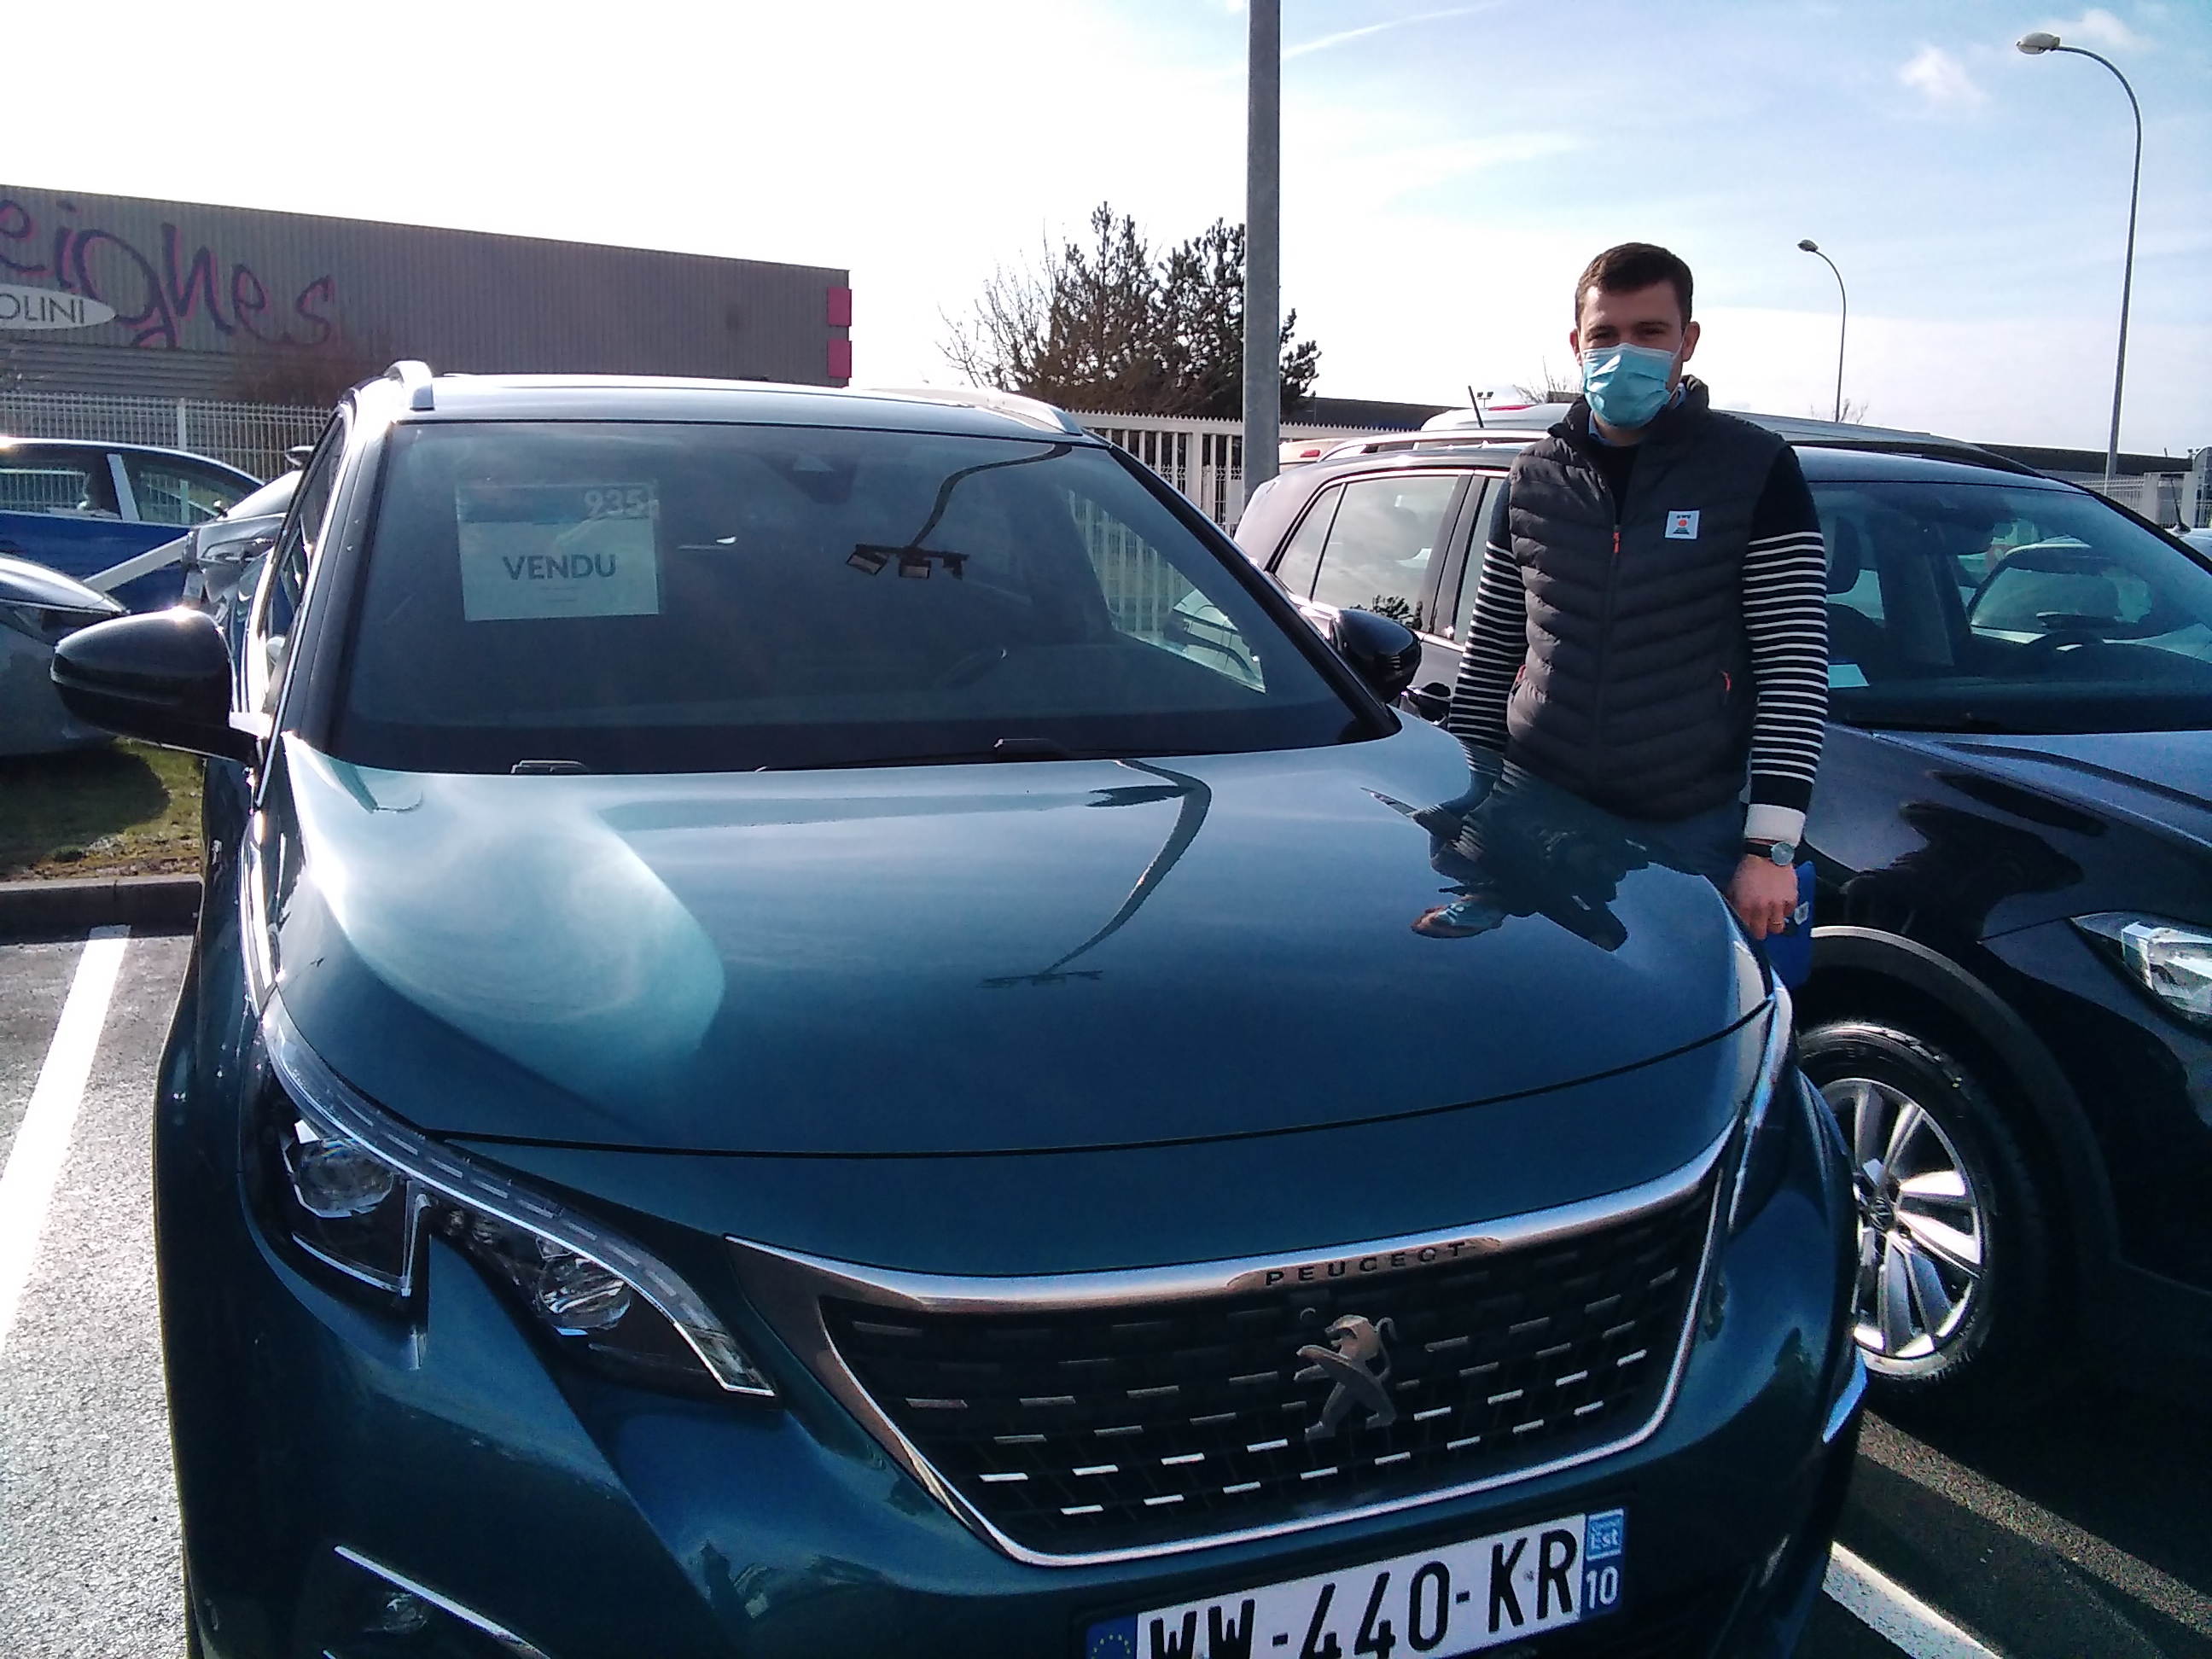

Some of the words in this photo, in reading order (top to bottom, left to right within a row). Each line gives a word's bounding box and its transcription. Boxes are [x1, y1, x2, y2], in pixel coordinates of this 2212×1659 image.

[0, 293, 84, 323] OLINI
[503, 554, 616, 580] VENDU
[1586, 1565, 1619, 1610] 10
